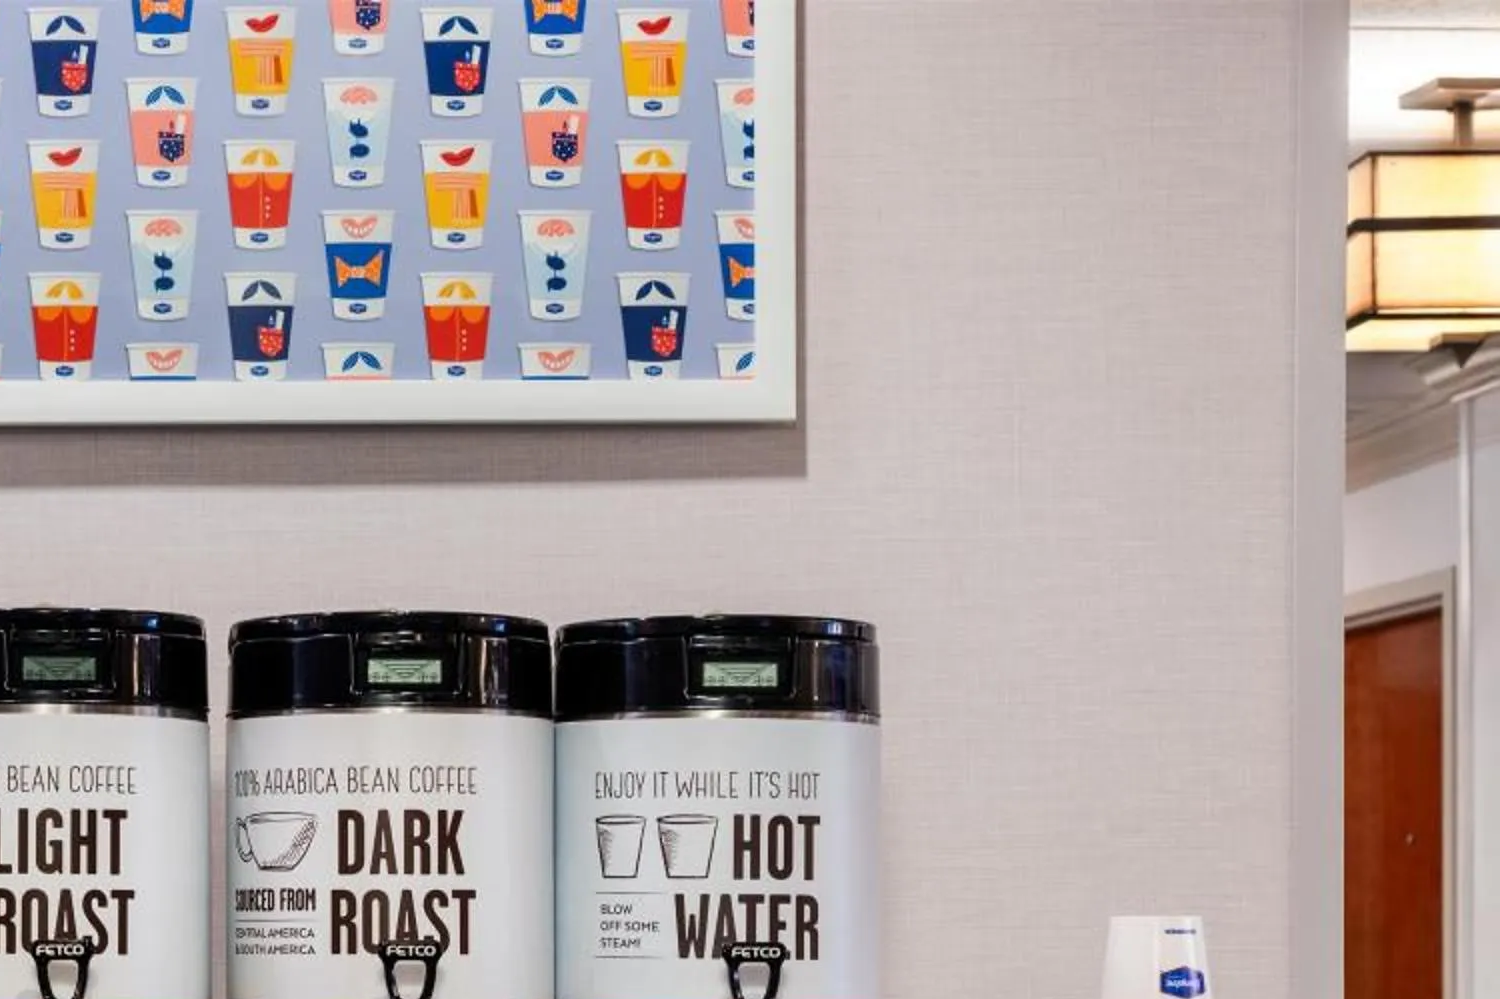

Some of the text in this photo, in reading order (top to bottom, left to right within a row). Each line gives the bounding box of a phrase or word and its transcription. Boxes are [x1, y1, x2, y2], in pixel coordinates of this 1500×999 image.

[7, 764, 60, 793] BEAN
[69, 765, 138, 795] COFFEE
[263, 766, 339, 796] ARABICA
[346, 765, 400, 794] BEAN
[409, 765, 477, 795] COFFEE
[595, 771, 821, 800] ENJOY IT WHILE IT'S HOT
[337, 808, 465, 875] DARK
[733, 813, 821, 881] HOT
[280, 887, 316, 912] FROM
[599, 903, 633, 915] BLOW
[268, 927, 315, 939] AMERICA
[330, 889, 477, 956] ROAST
[599, 921, 660, 933] OFF SOME
[674, 893, 820, 961] WATER
[35, 943, 85, 957] FETCO
[267, 943, 316, 955] AMERICA
[386, 945, 437, 957] FETCO
[731, 946, 781, 959] FETCO
